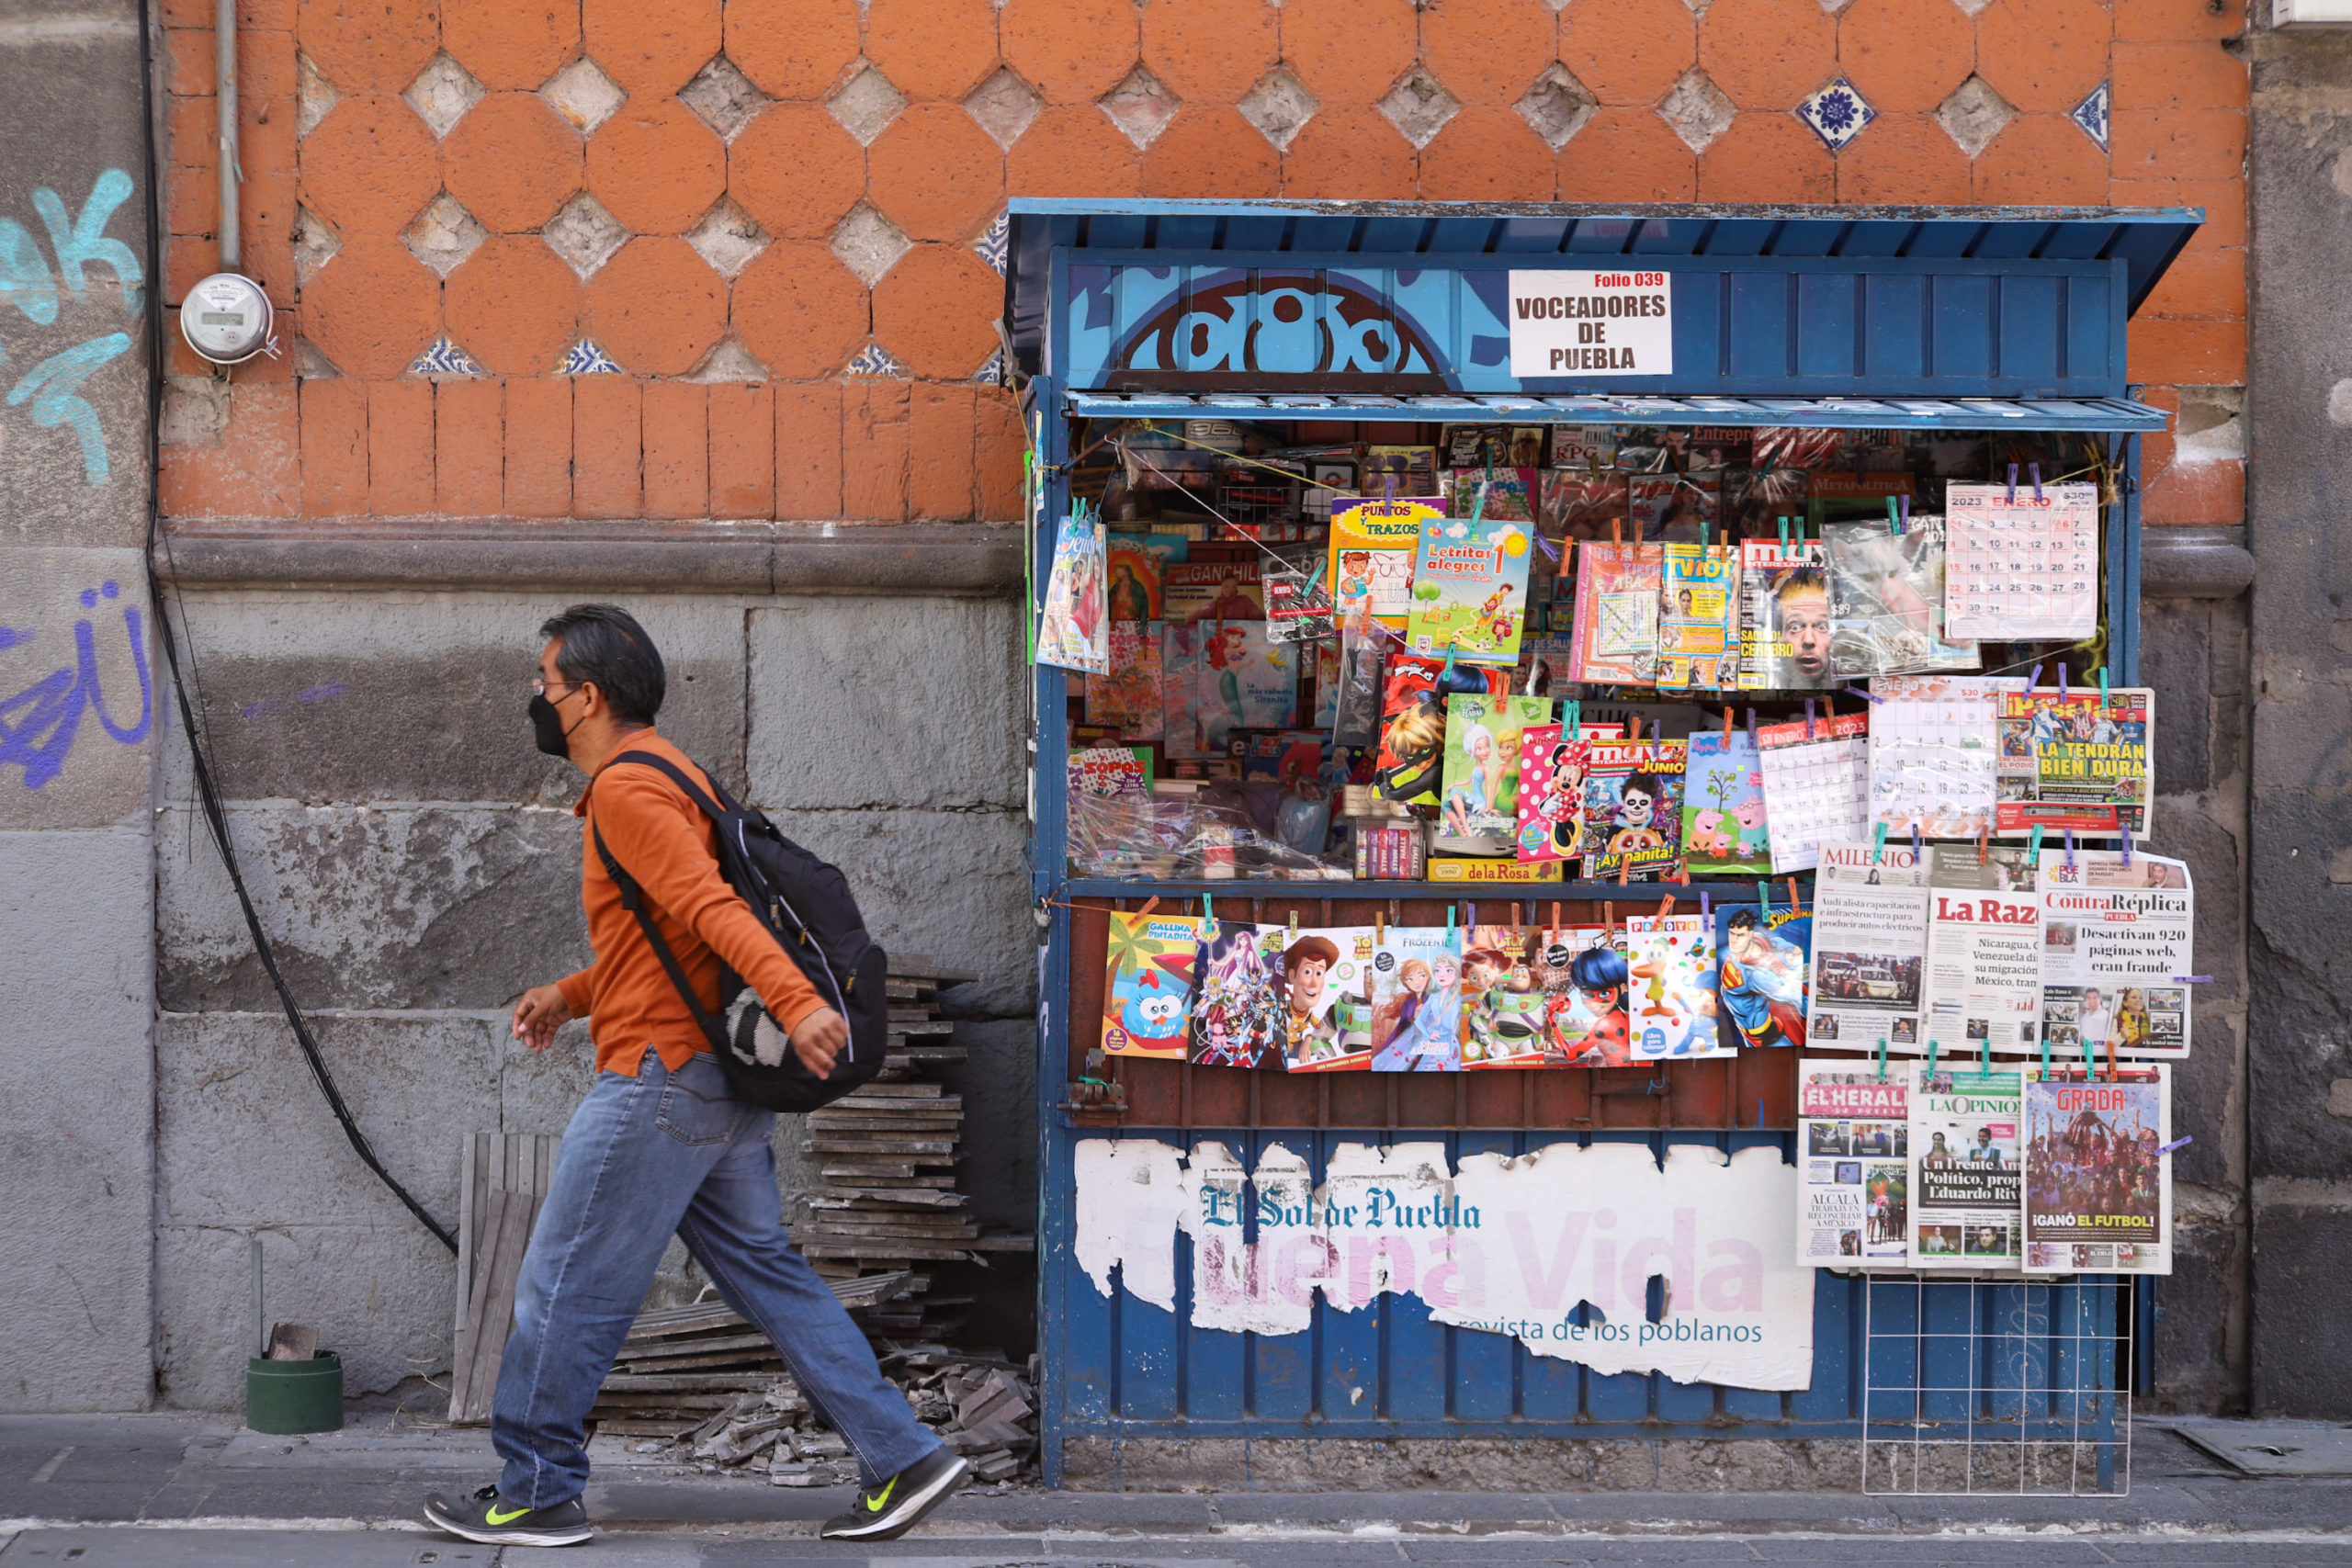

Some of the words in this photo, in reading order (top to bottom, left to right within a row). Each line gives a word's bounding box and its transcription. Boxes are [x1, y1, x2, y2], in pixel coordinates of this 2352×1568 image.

[1594, 274, 1629, 288] Folio
[1634, 272, 1664, 288] 039
[1516, 296, 1666, 320] VOCEADORES
[1578, 322, 1605, 344] DE
[1550, 348, 1636, 371] PUEBLA
[1555, 446, 1597, 459] RPG
[1951, 498, 1982, 506] 2023
[1993, 497, 2051, 507] ENERO
[1360, 517, 1367, 525] Y
[1366, 524, 1419, 535] TRAZOS
[1427, 559, 1486, 572] alegres
[1429, 545, 1491, 558] Letritas
[1493, 545, 1505, 573] 1
[1836, 722, 1866, 735] 2023
[1774, 730, 1804, 743] ENERO
[2039, 742, 2059, 757] LA
[2065, 742, 2144, 760] TENDRÁN
[1084, 761, 1147, 773] SOPAS
[2041, 759, 2085, 775] BIEN
[2092, 760, 2144, 776] DURA
[1824, 848, 1915, 868] MILENIO
[1469, 864, 1482, 879] de
[1485, 864, 1495, 879] la
[1498, 863, 1530, 879] Rosa
[1823, 897, 1841, 906] Audi
[1843, 898, 1864, 907] alista
[1866, 900, 1920, 910] capacitación
[2046, 892, 2187, 915] ContraRéplica
[1826, 908, 1891, 919] infraestructura
[1937, 897, 1973, 921] La
[1980, 899, 2039, 925] Raz
[2105, 913, 2136, 921] PUEBLA
[1149, 922, 1192, 931] GALLINA
[1819, 920, 1857, 930] producir
[1148, 931, 1193, 941] PINTADITA
[2081, 927, 2155, 941] Desactivan
[2159, 930, 2186, 942] 920
[1403, 938, 1440, 947] FROZEN
[1979, 939, 2030, 951] Nicaragua,
[1973, 952, 2024, 962] Venezuela
[2089, 944, 2142, 958] páginas
[2146, 945, 2176, 958] web,
[1988, 964, 2038, 976] migración
[2091, 962, 2122, 973] eran
[2127, 961, 2172, 974] fraude
[1975, 976, 2015, 987] México,
[1807, 1089, 1829, 1105] EL
[2057, 1089, 2124, 1111] GRADA
[1929, 1099, 1951, 1111] LA
[1923, 1158, 1943, 1169] Un
[1948, 1159, 1994, 1169] Frente
[1924, 1172, 1984, 1185] Político,
[1811, 1193, 1859, 1205] ALCALÁ
[1929, 1187, 1992, 1199] Eduardo
[1200, 1185, 1244, 1227] El
[1256, 1186, 1313, 1227] Sol
[1328, 1194, 1359, 1228] de
[1366, 1188, 1481, 1229] Puebla
[2032, 1213, 2076, 1226] ¡GANÓ
[2077, 1215, 2092, 1226] EL
[2095, 1215, 2154, 1227] FUTBOL!
[1504, 1207, 1764, 1312] Vida
[1553, 1317, 1585, 1342] de
[1639, 1318, 1762, 1347] poblanos
